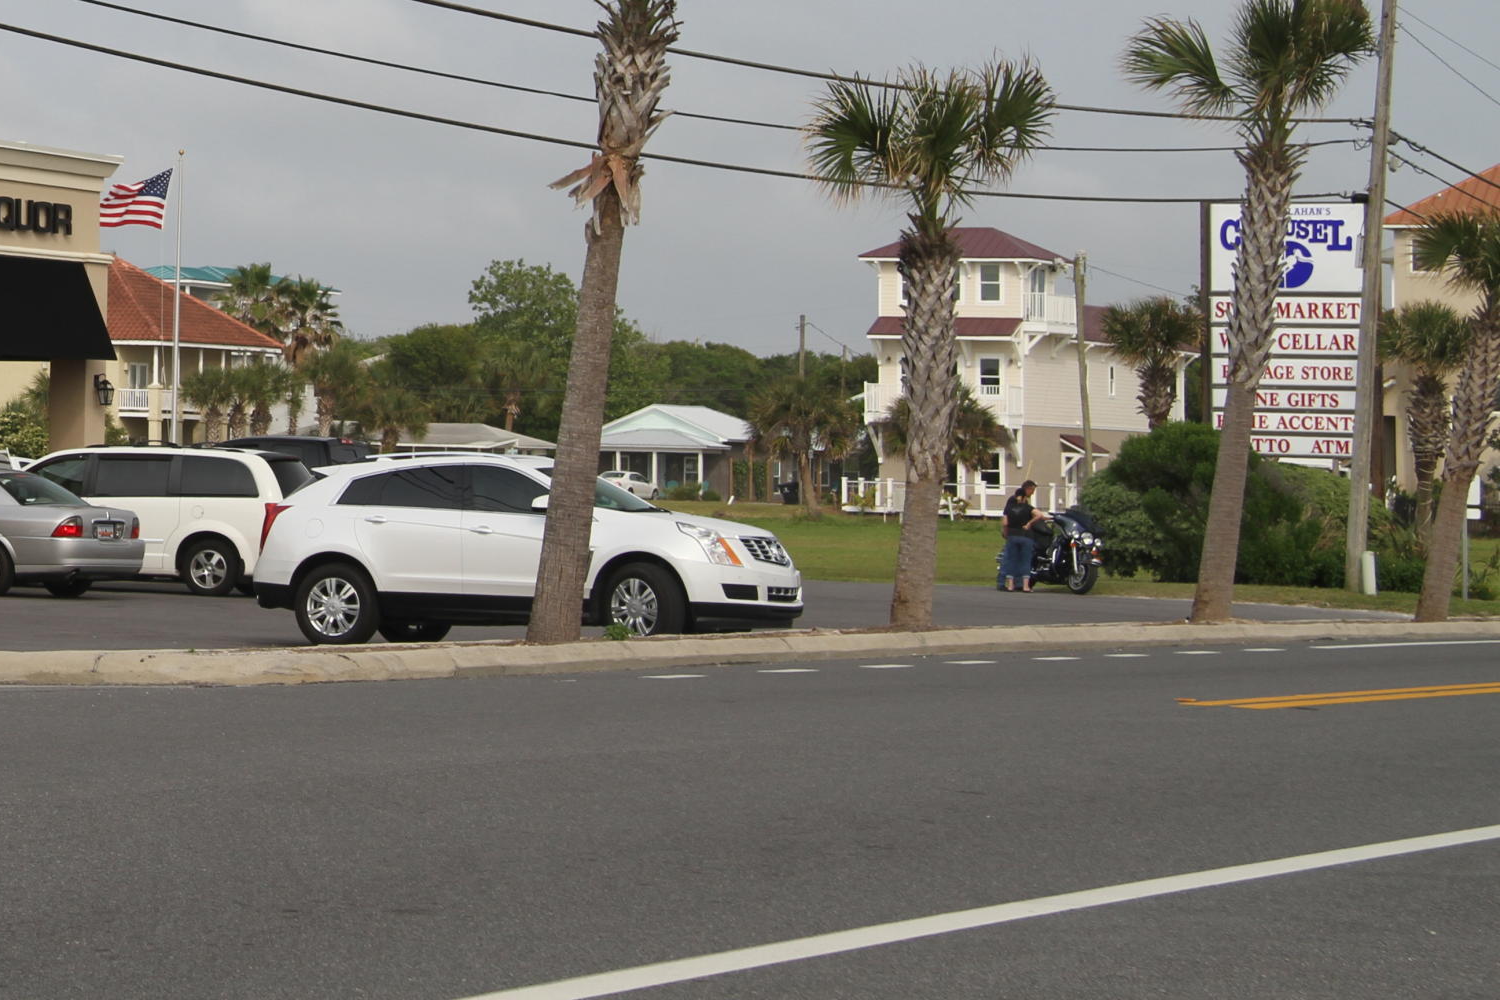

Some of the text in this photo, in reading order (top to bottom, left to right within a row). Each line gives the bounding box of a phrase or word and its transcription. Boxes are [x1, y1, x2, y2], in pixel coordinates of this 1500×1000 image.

[1287, 207, 1332, 217] LAHAN'S
[1219, 218, 1353, 252] CUSEL
[1277, 332, 1357, 351] CELLAR
[1301, 365, 1354, 381] STORE
[1287, 392, 1340, 409] GIFTS
[1251, 437, 1351, 455] TTO ATM
